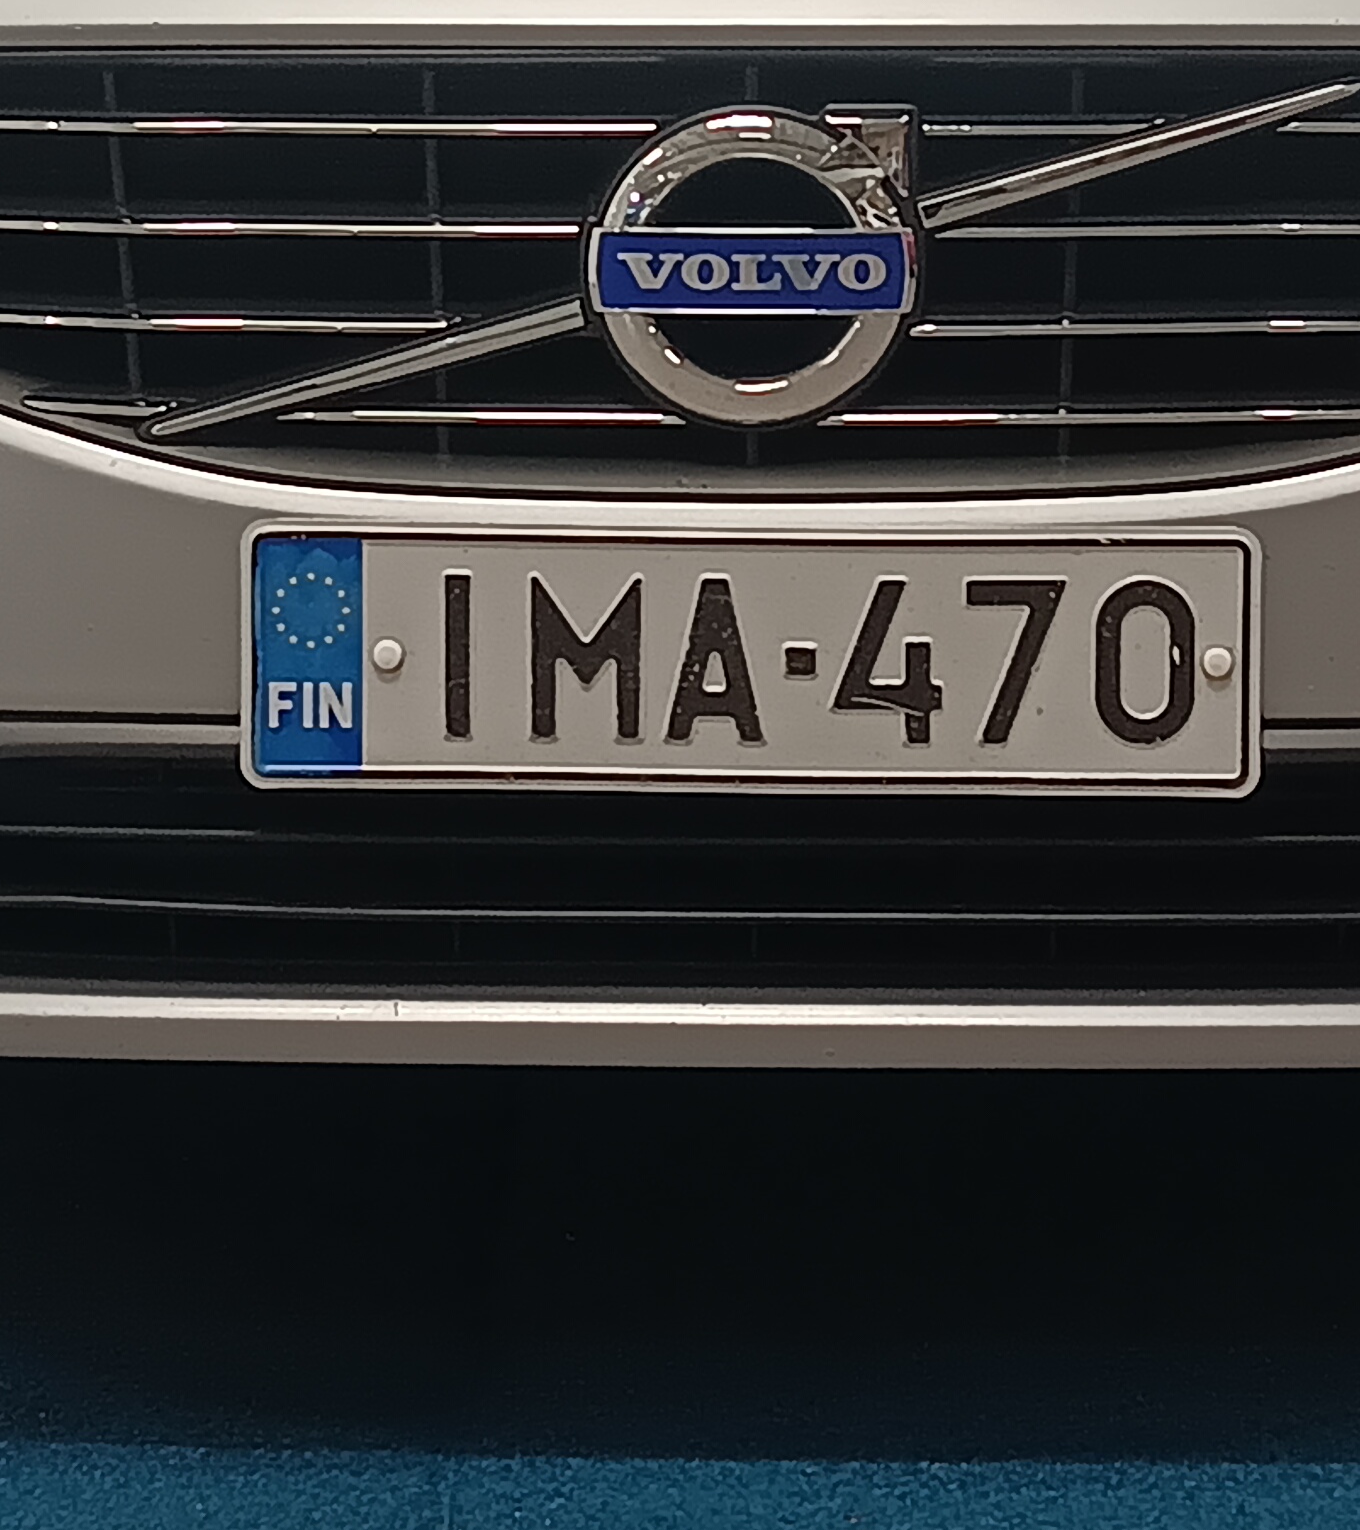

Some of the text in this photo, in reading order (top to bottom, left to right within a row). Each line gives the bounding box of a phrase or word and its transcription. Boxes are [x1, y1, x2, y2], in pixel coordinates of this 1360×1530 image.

[616, 252, 888, 291] VOLVO
[441, 569, 1196, 746] IMA-470
[268, 680, 353, 730] FIN
